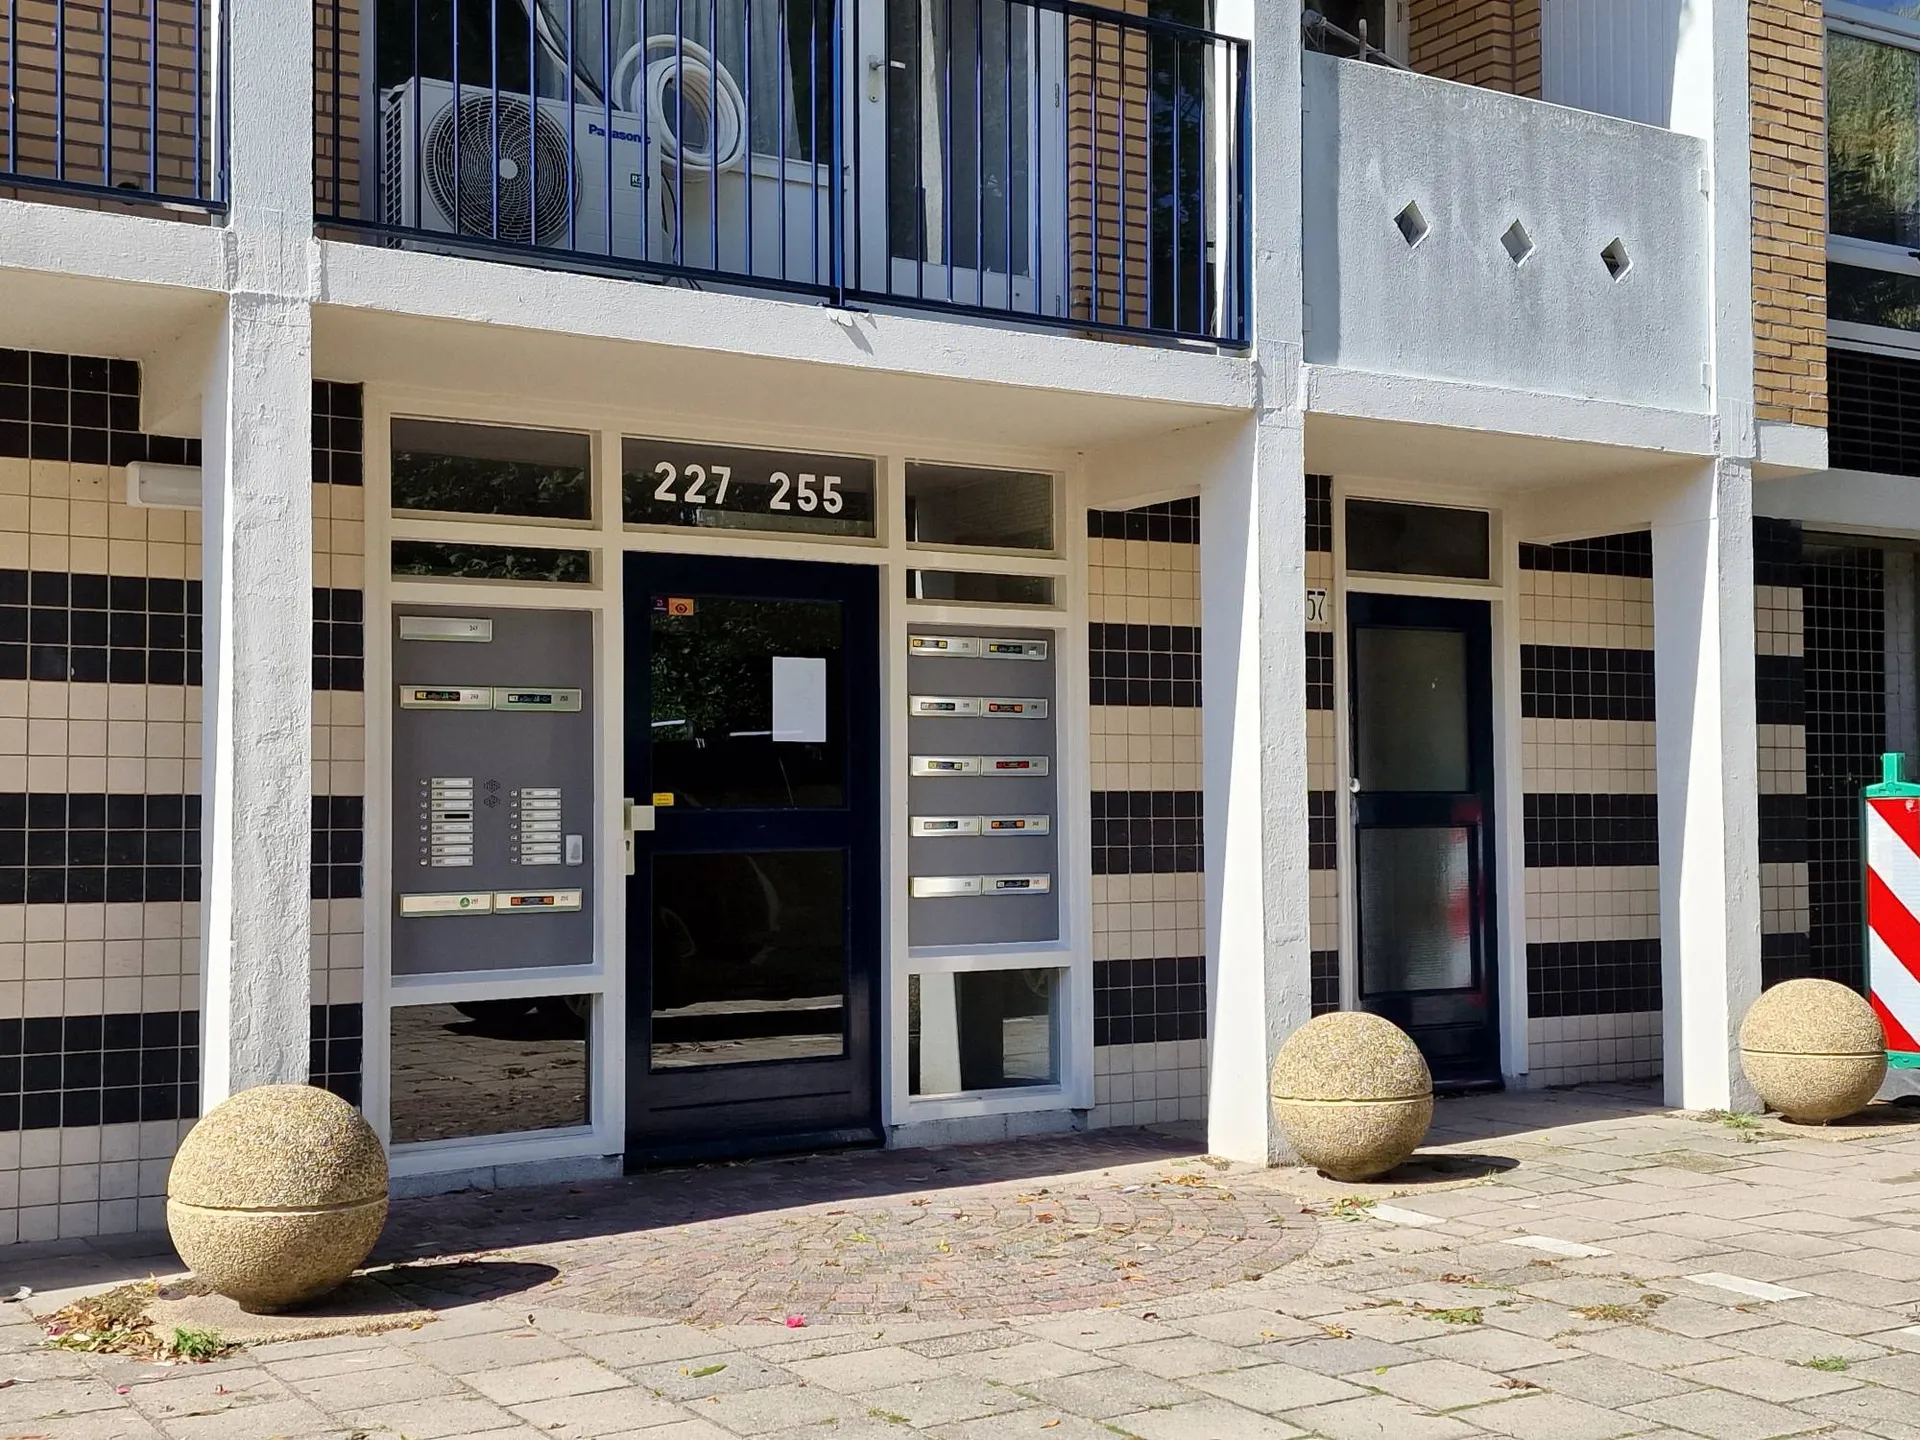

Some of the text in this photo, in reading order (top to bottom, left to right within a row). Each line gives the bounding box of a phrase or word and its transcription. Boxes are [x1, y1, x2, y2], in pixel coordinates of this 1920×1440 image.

[588, 123, 652, 145] Paasonc
[653, 460, 844, 515] 227 255
